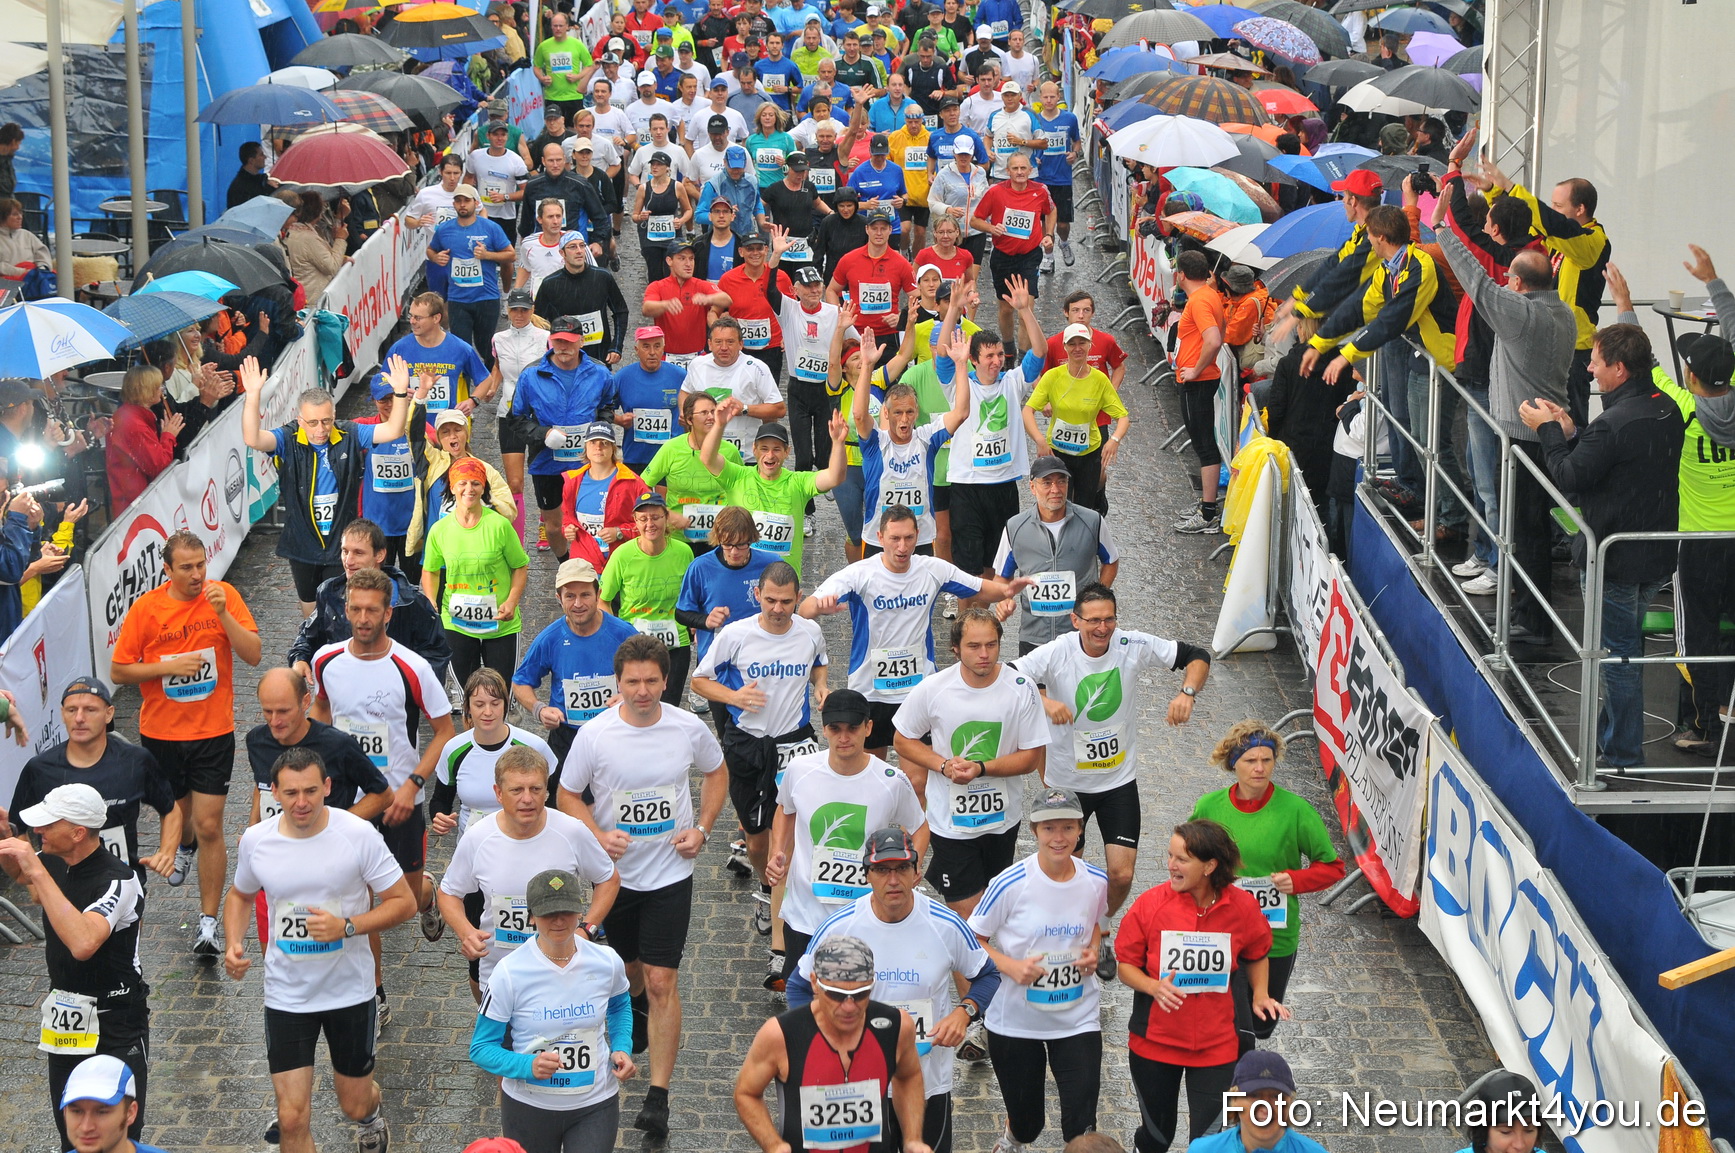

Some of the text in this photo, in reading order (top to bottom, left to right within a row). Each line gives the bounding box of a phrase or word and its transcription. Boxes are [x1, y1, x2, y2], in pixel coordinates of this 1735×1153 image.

[552, 57, 572, 67] 3302
[811, 174, 833, 185] 2619
[650, 222, 672, 232] 2861
[1005, 215, 1031, 230] 3393
[454, 265, 479, 277] 3075
[862, 291, 889, 304] 2542
[741, 326, 768, 339] 2543
[799, 356, 828, 373] 2458
[636, 416, 668, 432] 2344
[1054, 428, 1087, 445] 2919
[975, 438, 1007, 457] 2467
[984, 457, 1003, 467] Stefan
[376, 463, 410, 479] 2530
[885, 489, 923, 505] 2718
[756, 523, 792, 542] 2487
[1031, 582, 1071, 601] 2432
[873, 592, 929, 611] Gothaer
[454, 605, 494, 621] 2484
[747, 661, 808, 680] Gothaer
[877, 658, 919, 678] 2431
[177, 684, 207, 697] Stephan
[885, 677, 913, 689] Gerhard
[569, 688, 613, 709] 2303
[583, 711, 601, 720] Pete
[1086, 737, 1120, 761] 309
[1092, 759, 1117, 769] Robert
[955, 792, 1005, 814] 3205
[619, 799, 672, 823] 2626
[629, 824, 663, 836] Manfred
[818, 861, 869, 886] 2223
[830, 886, 854, 898] Josef
[1045, 923, 1085, 938] heinloth
[289, 942, 330, 954] Christian
[1167, 947, 1225, 973] 2609
[1178, 975, 1210, 987] yvonne
[1048, 991, 1069, 1002] Anita
[50, 1006, 86, 1031] 242
[543, 1001, 596, 1021] heinloth
[54, 1036, 78, 1048] georg
[550, 1075, 571, 1088] Inge
[809, 1099, 874, 1127] 3253
[829, 1128, 854, 1141] Gerd
